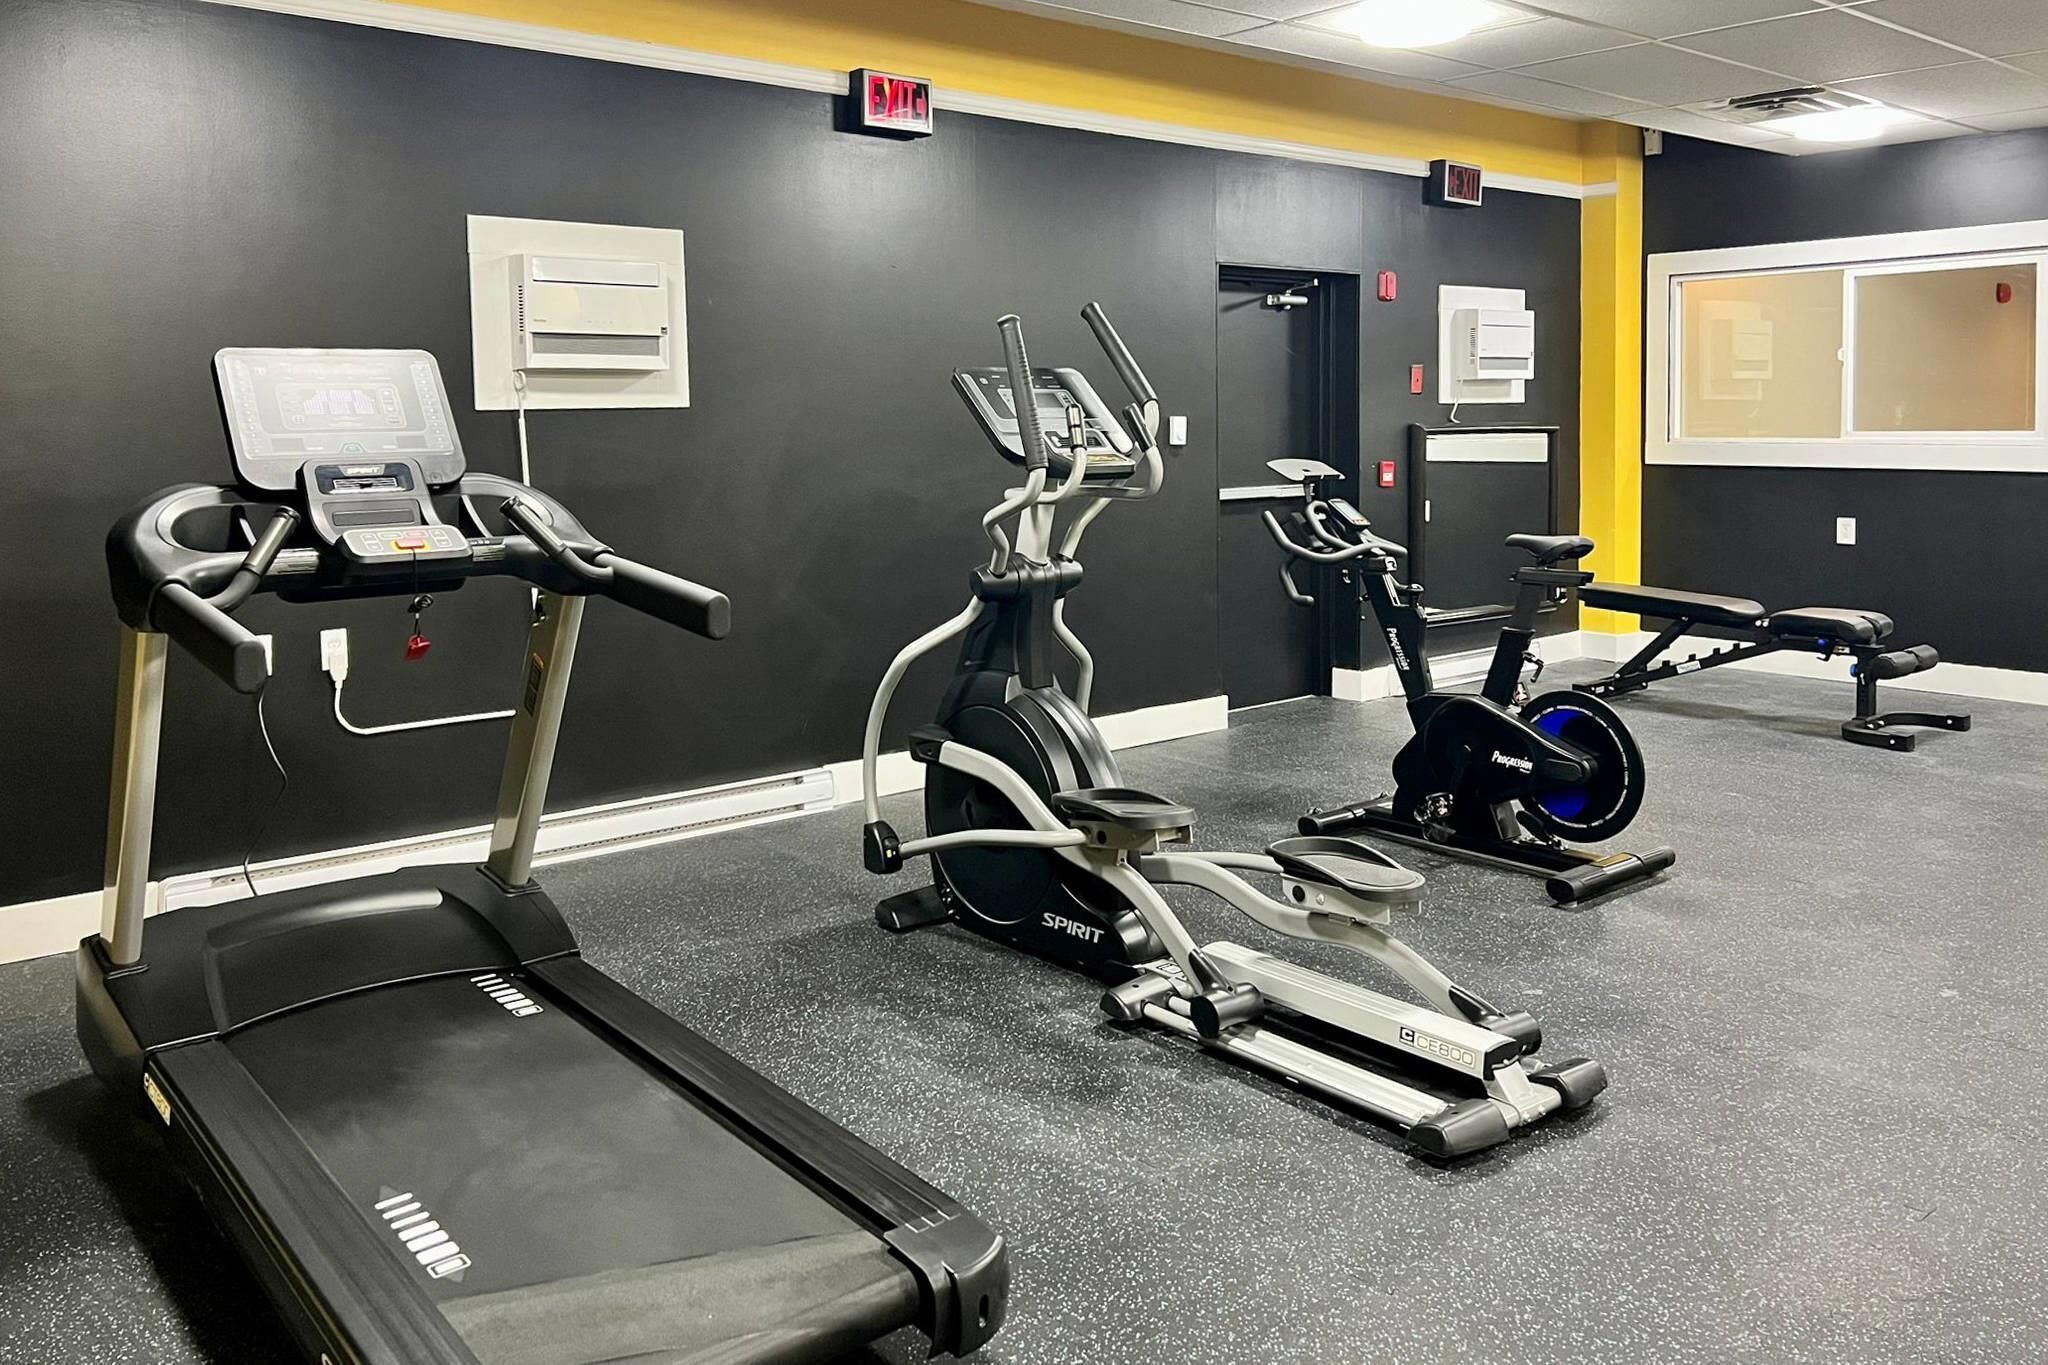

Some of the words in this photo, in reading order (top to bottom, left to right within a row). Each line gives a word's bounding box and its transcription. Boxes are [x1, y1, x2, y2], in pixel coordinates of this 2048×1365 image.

[869, 75, 917, 120] EXIT
[1041, 912, 1105, 944] SPIRIT
[1417, 1035, 1474, 1066] CE800
